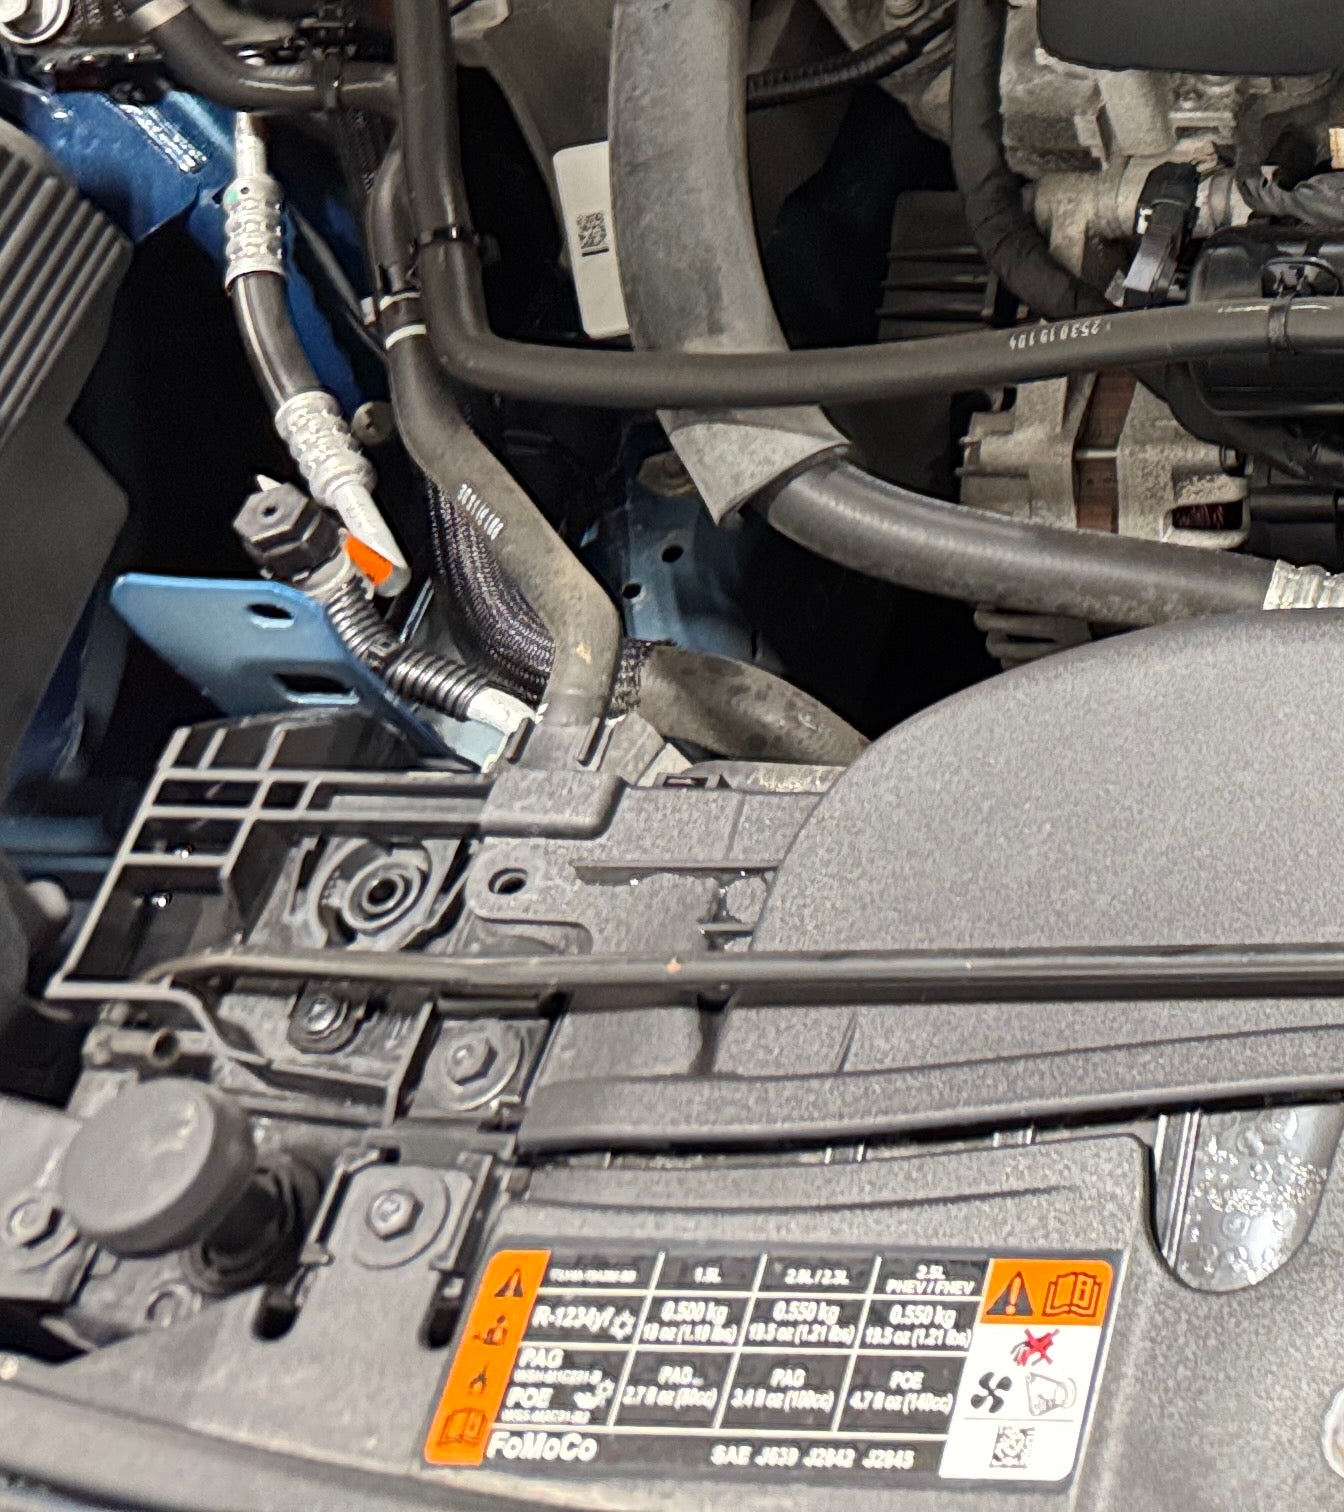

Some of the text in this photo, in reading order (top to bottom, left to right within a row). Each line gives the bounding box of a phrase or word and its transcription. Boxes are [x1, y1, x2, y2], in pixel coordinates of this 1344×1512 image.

[531, 1304, 617, 1332] R-1234yf
[660, 1300, 730, 1326] 0.500 kg
[773, 1301, 841, 1325] 0.550 kg
[889, 1305, 957, 1330] 0.550 kg
[518, 1348, 565, 1368] PAG
[657, 1365, 694, 1386] PAG
[770, 1367, 807, 1388] PAG
[889, 1370, 925, 1390] POE
[506, 1386, 554, 1408] POE
[486, 1429, 598, 1462] FoMoCo
[710, 1444, 753, 1466] SAE
